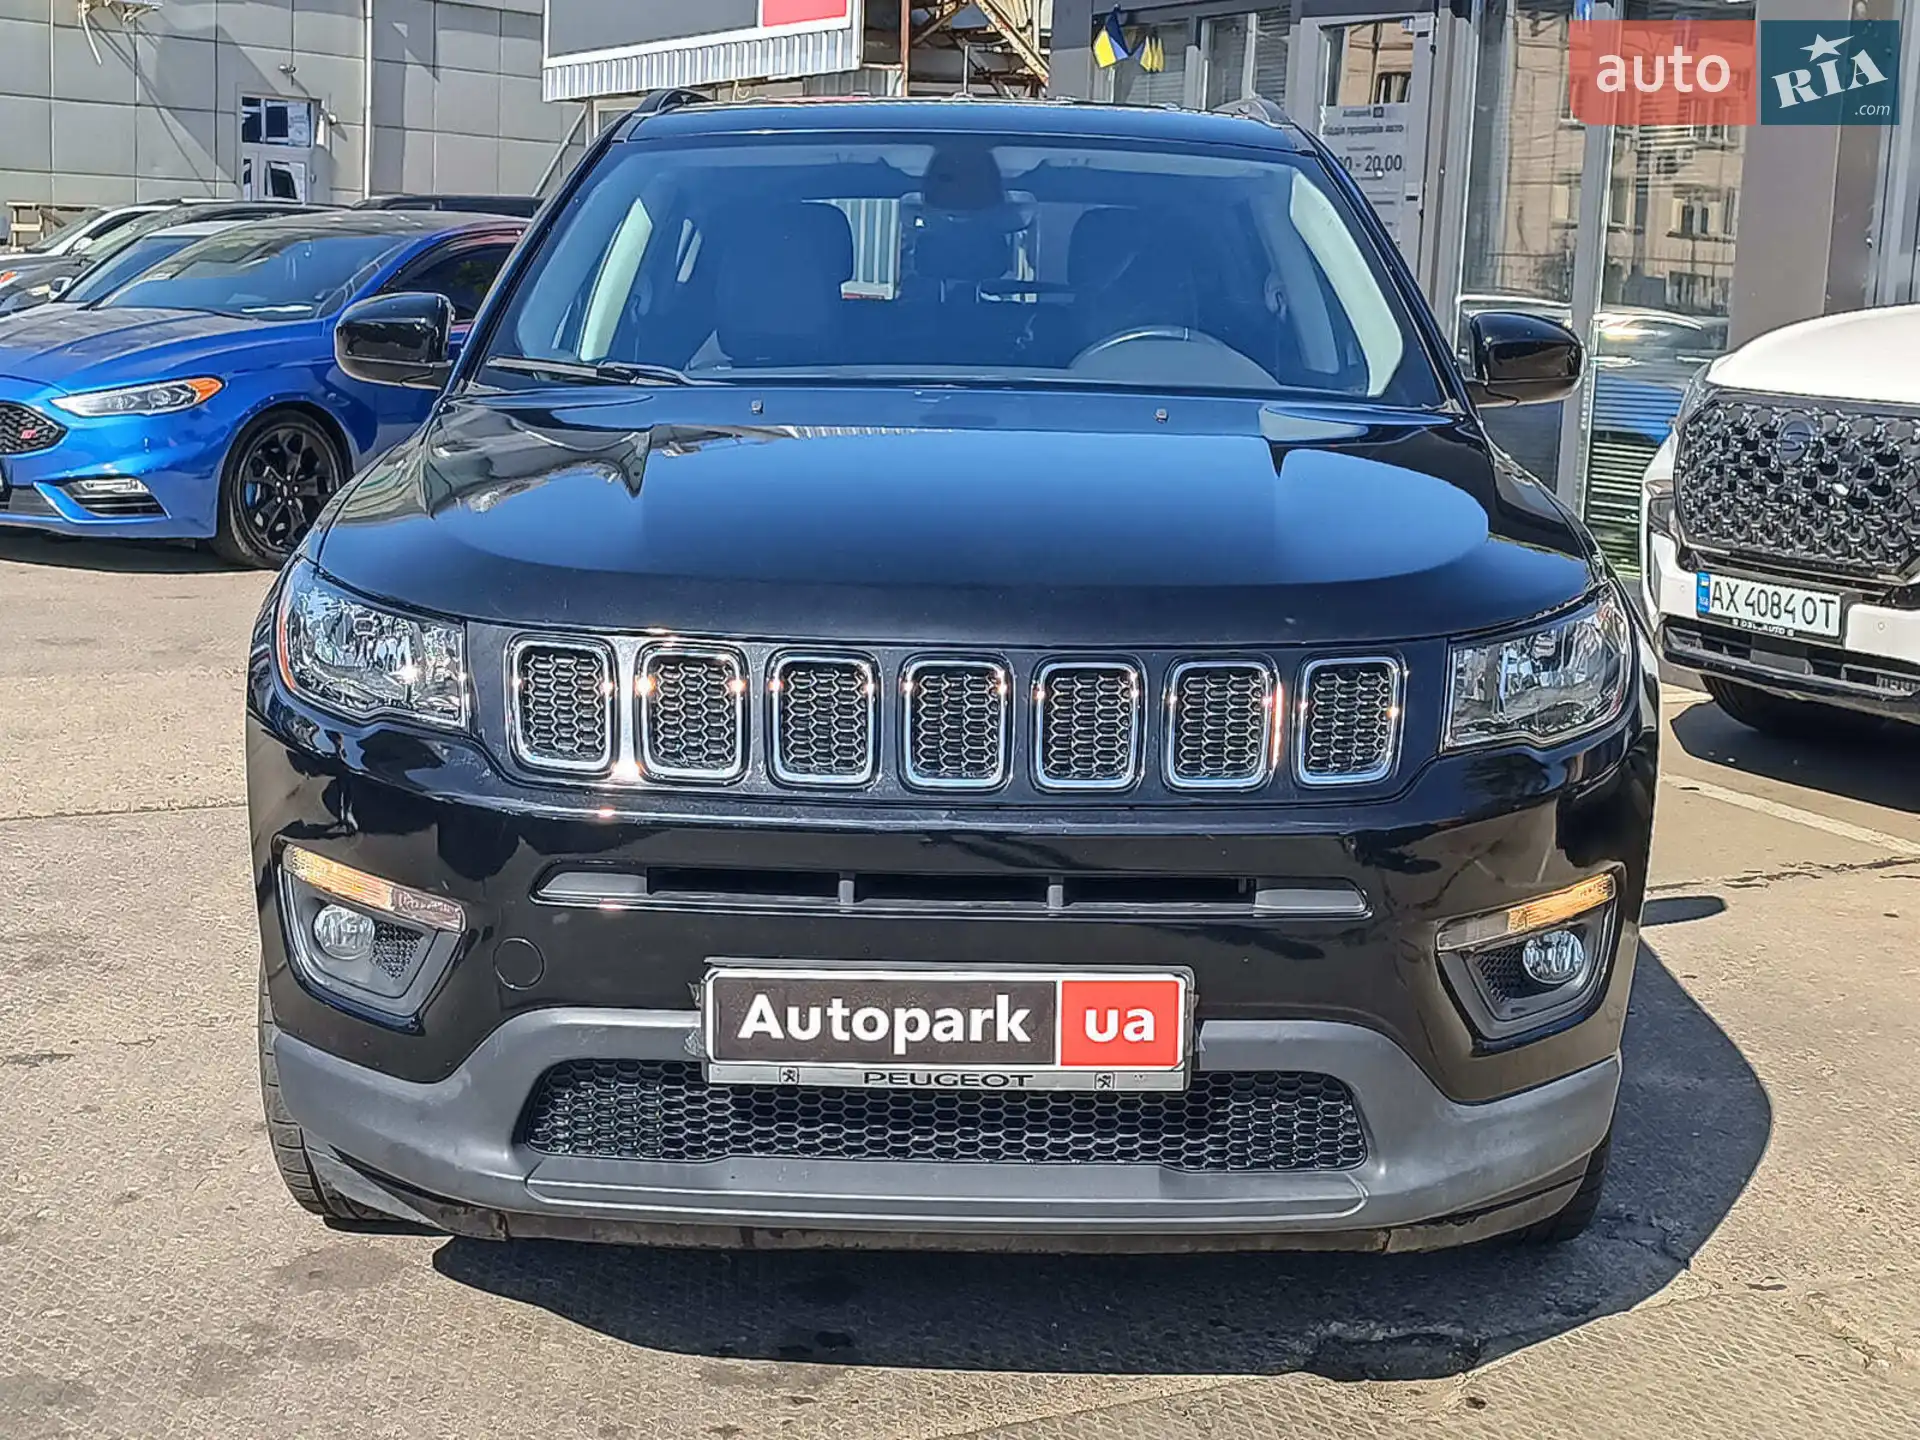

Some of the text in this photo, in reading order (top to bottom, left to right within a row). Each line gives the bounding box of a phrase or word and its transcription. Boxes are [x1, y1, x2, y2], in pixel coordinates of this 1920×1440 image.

[1711, 580, 1836, 629] AX 4084 OT
[738, 994, 1155, 1055] Autopark ua
[862, 1071, 1035, 1088] PEUGEOT
